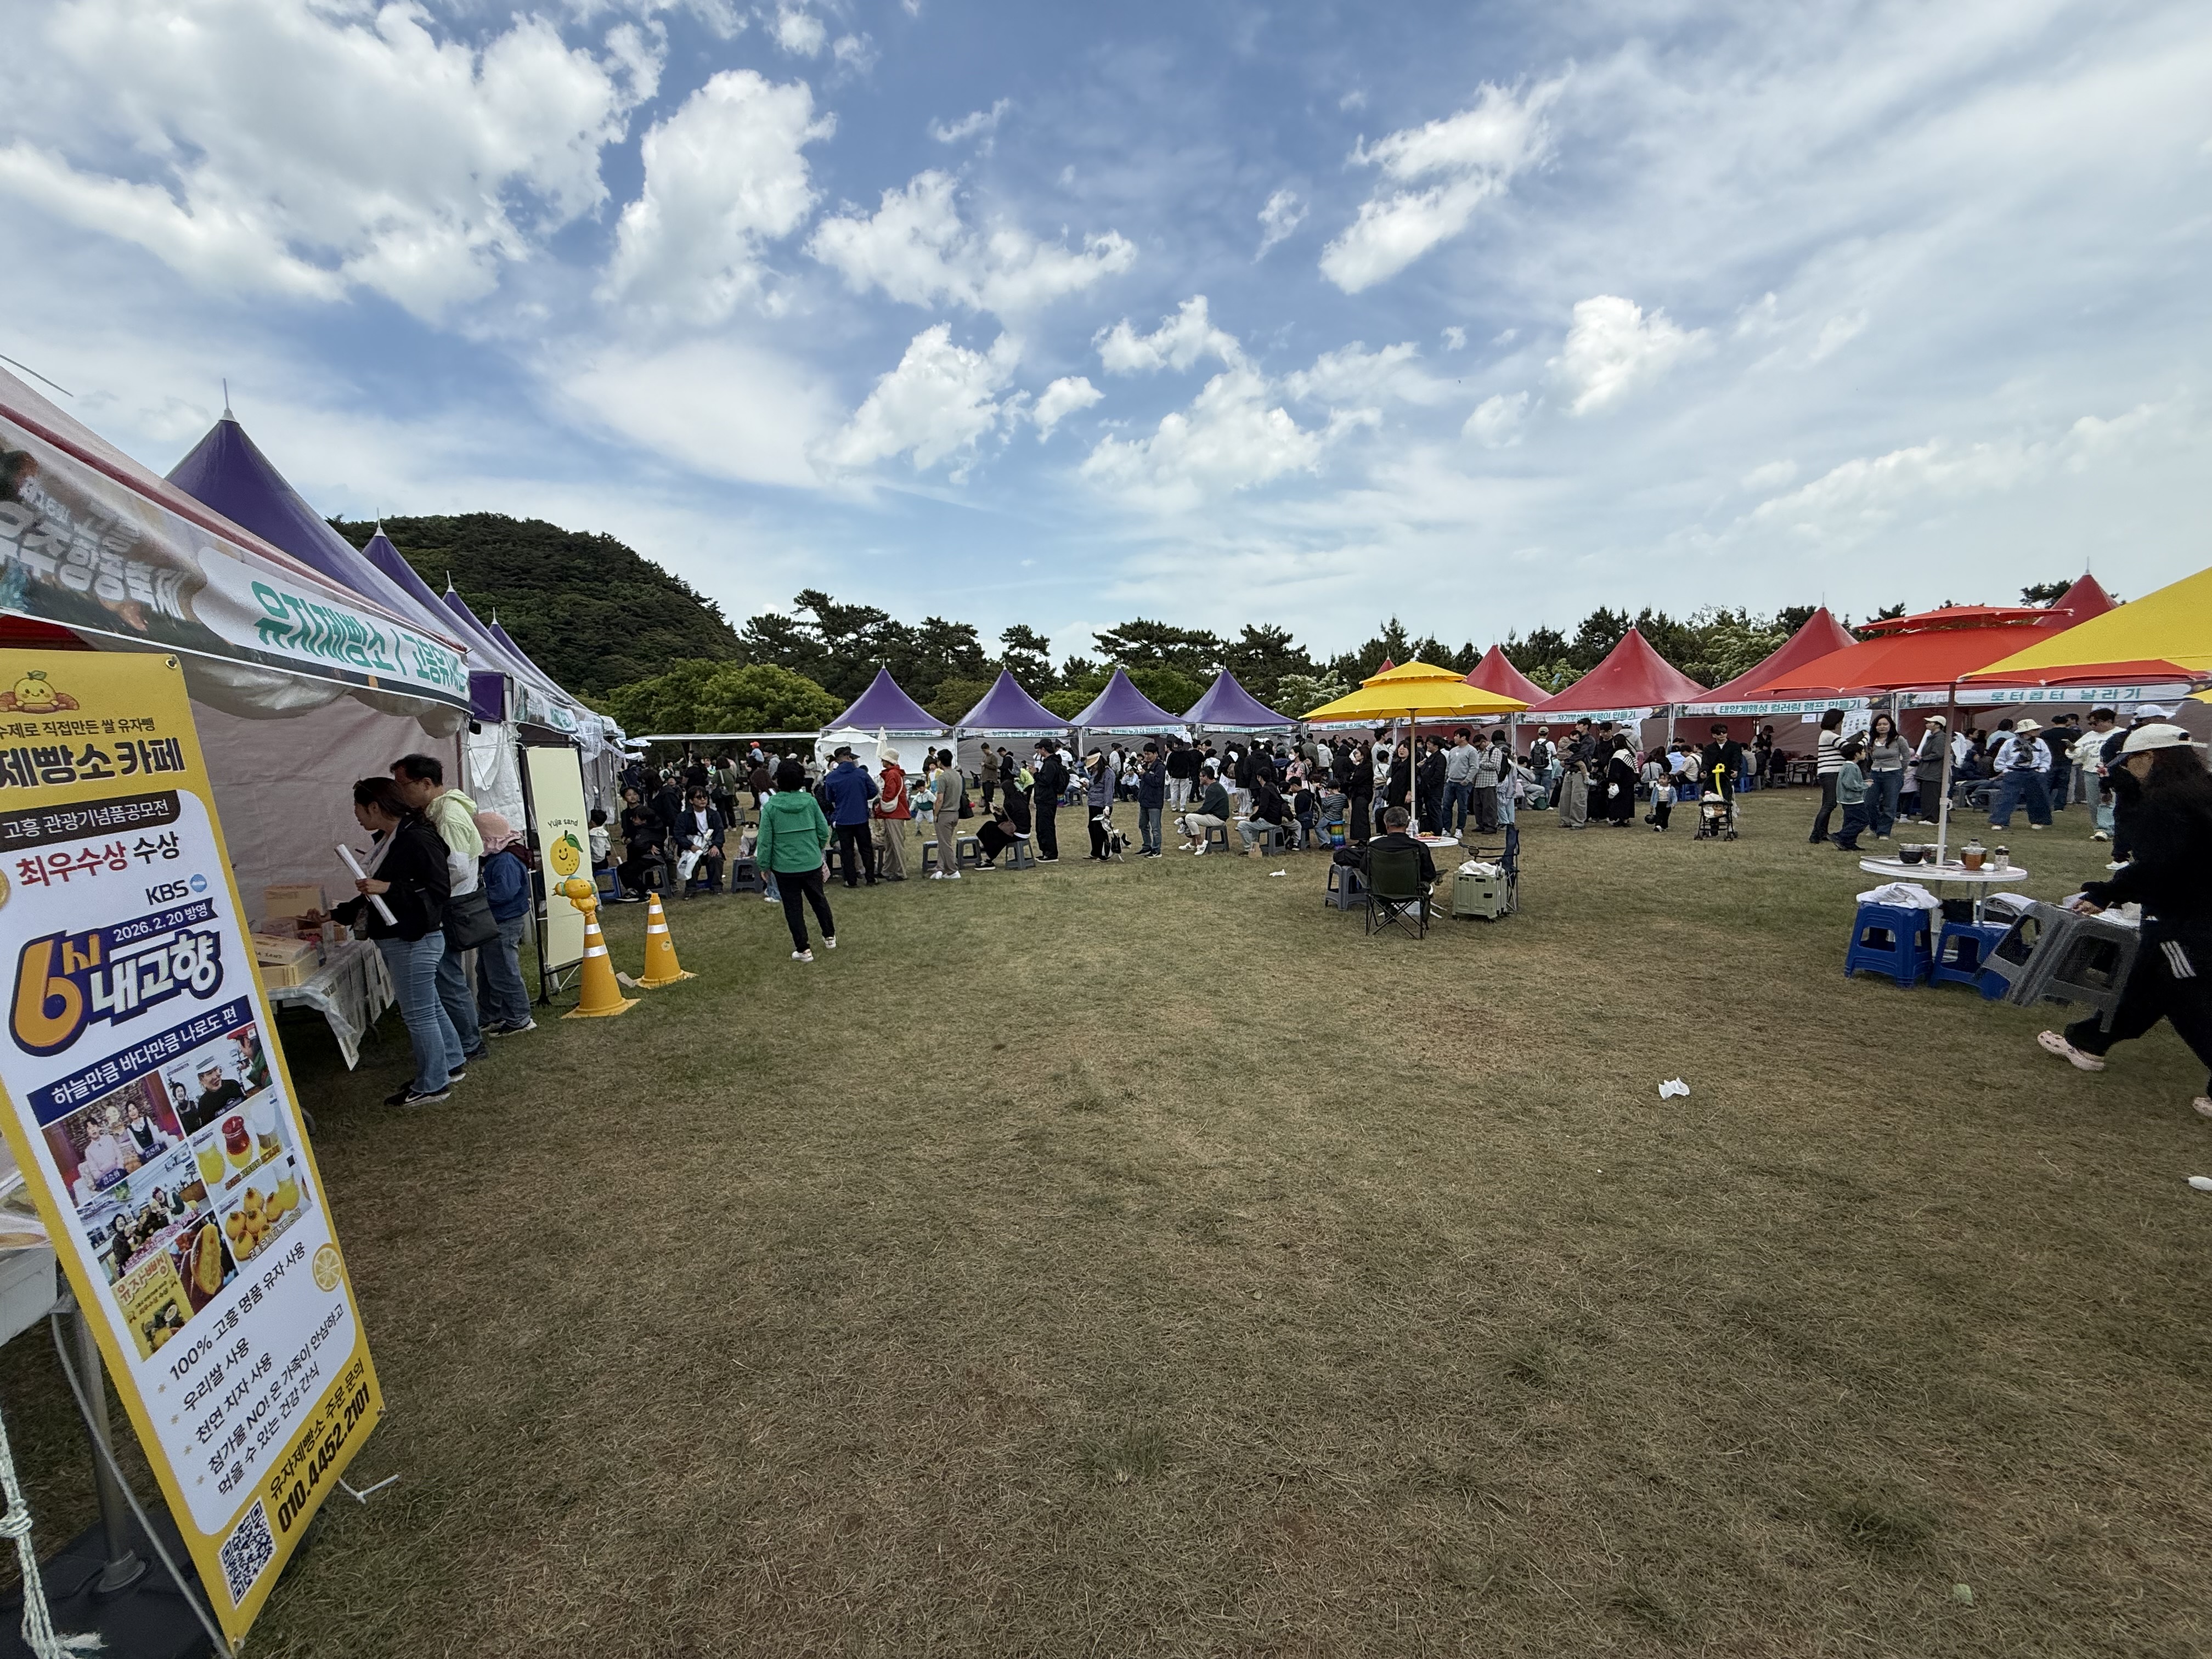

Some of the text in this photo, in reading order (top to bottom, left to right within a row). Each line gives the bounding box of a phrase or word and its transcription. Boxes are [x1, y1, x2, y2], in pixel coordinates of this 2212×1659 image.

[251, 581, 396, 672] 유자제빵소
[42, 720, 100, 736] 직접만든
[101, 720, 115, 734] 쌀
[1771, 702, 1801, 713] 컬러링
[1804, 701, 1825, 711] 램프
[4, 799, 170, 839] 고흥 관광기념품공모전
[16, 831, 180, 887] 최우수상 수상
[146, 880, 189, 905] KBS
[184, 902, 208, 920] 방영
[90, 933, 217, 1014] 내고향
[51, 1063, 120, 1105] 하늘만큼
[120, 1035, 180, 1071] 바다만큼
[180, 1016, 222, 1043] 나로도
[223, 1005, 238, 1024] 편
[170, 1242, 306, 1381] 100% 고흥 명품 유자 사용
[183, 1338, 250, 1412] 우리쌀 사용
[195, 1352, 273, 1444] 천연 치자 사용
[208, 1304, 344, 1475] 첨가물 NO! 온 가족이 안심하고
[218, 1361, 320, 1495] 먹을 수 있는 건강 간식
[271, 1357, 365, 1501] 유자제빵소 주문 문의
[277, 1381, 371, 1533] 010.4452.2101
